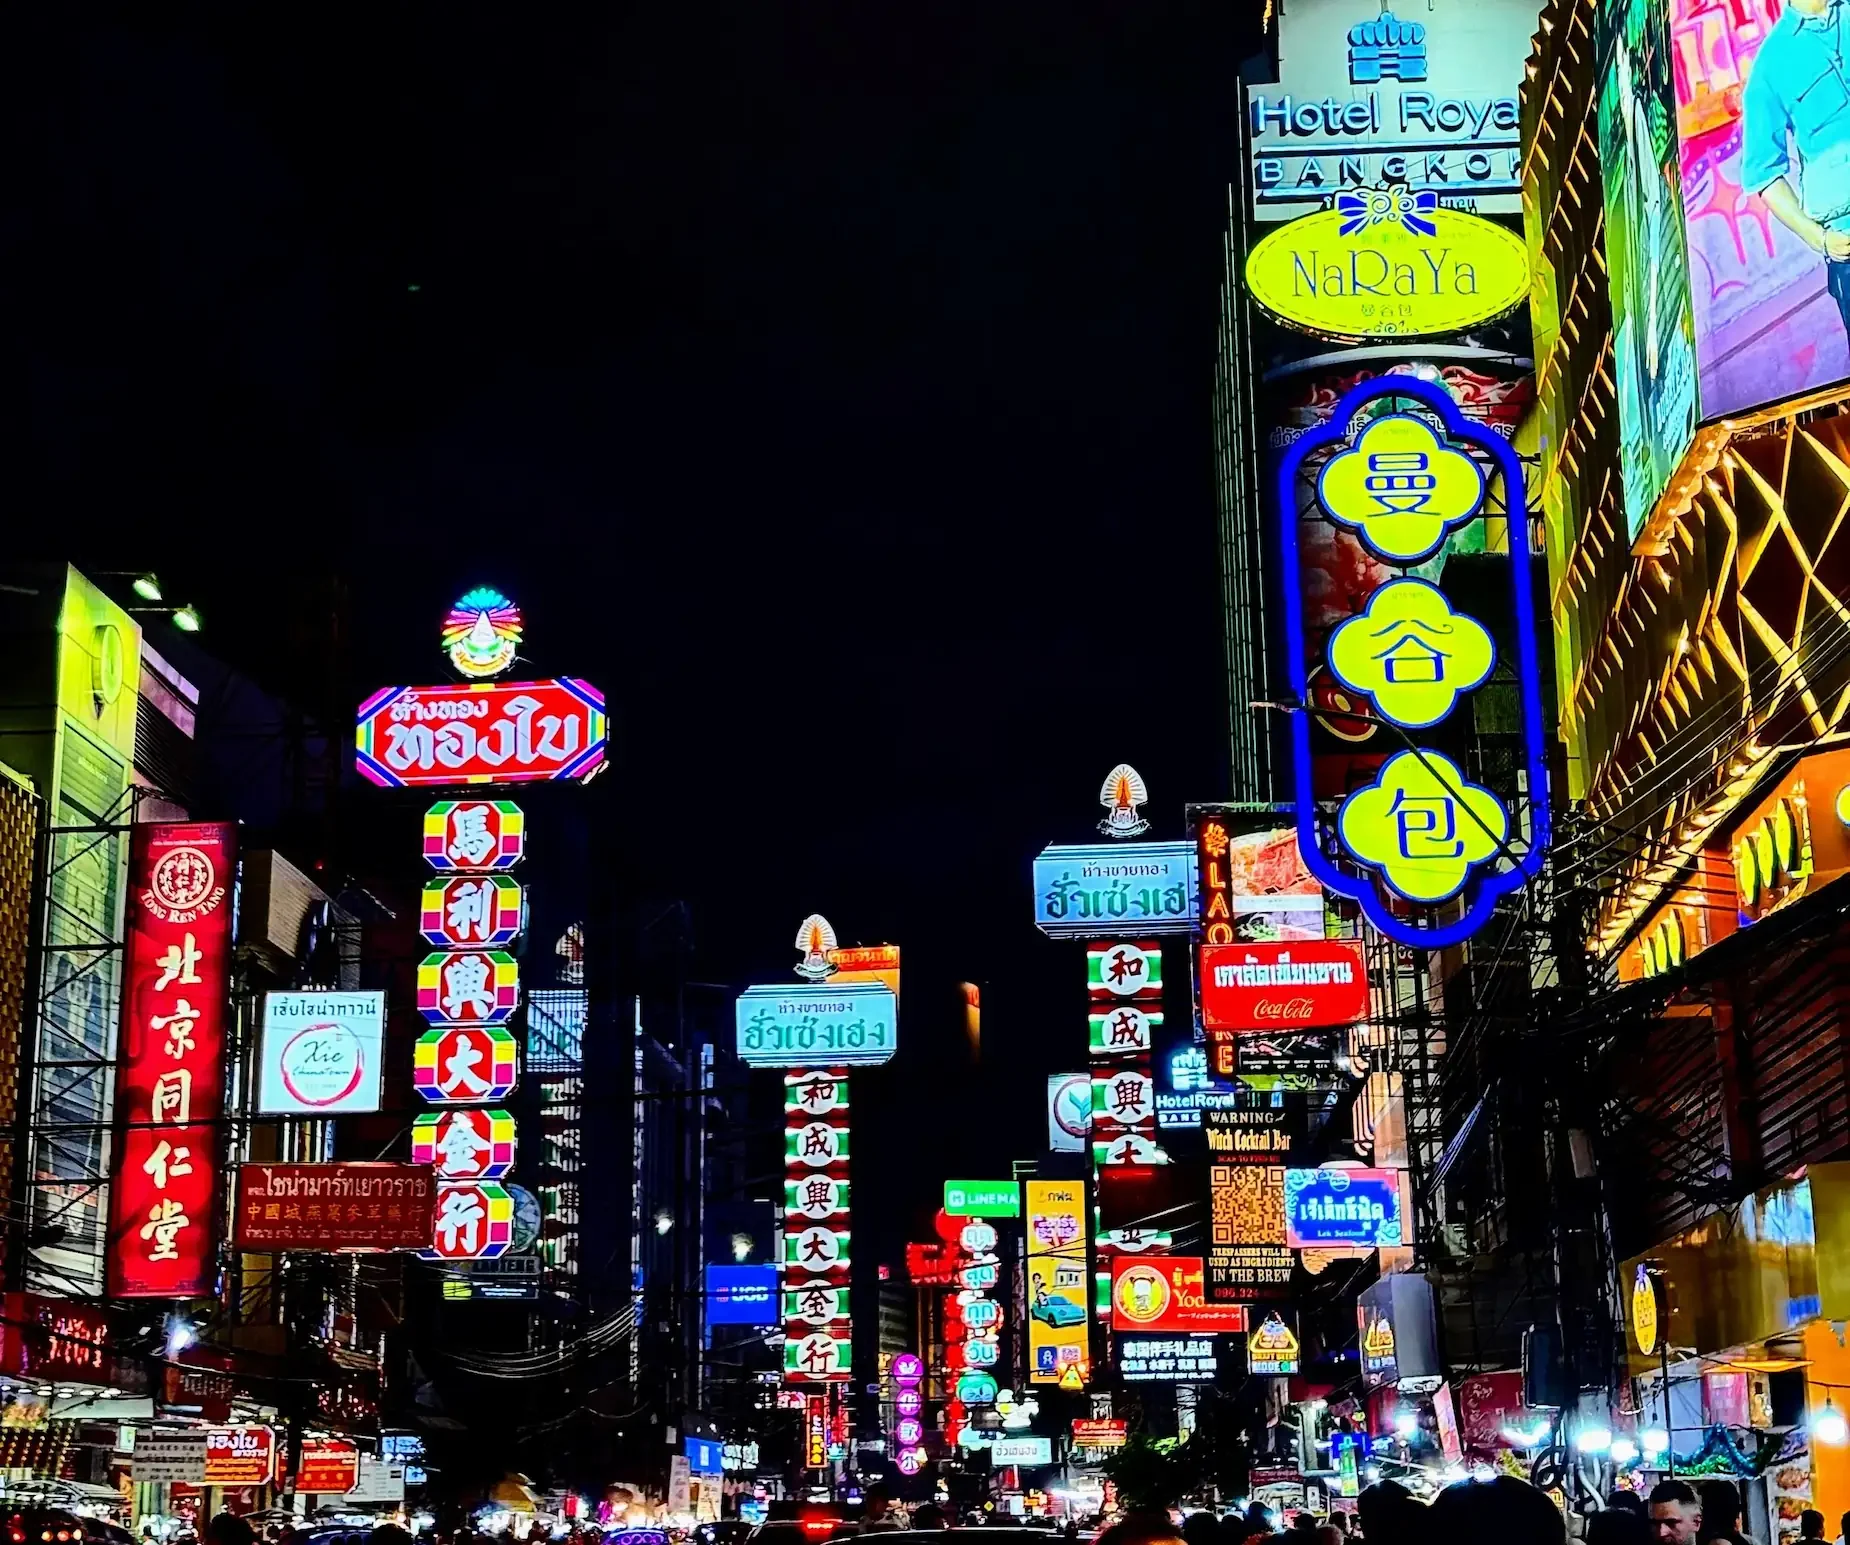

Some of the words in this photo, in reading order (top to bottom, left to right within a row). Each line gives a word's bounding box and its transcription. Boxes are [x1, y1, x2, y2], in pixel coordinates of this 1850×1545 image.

[1255, 93, 1381, 135] Hotel
[1400, 92, 1520, 140] Roya
[1290, 247, 1480, 297] NaRaYa
[1365, 452, 1465, 860] 曼谷包
[1082, 861, 1169, 878] ห้างขายทอง
[1045, 871, 1187, 919] ฮั่วเซ่งเฮ
[778, 1000, 853, 1014] ห้างขายทอง
[438, 806, 497, 1254] 馬利興大金行
[745, 1008, 886, 1050] ฮั่วเซ่งเฮง
[304, 1040, 344, 1063] Xie
[139, 932, 204, 1262] 北京同仁堂
[1156, 1094, 1195, 1108] Hotel
[1196, 1094, 1235, 1110] Royal
[1209, 1112, 1274, 1123] WARNING
[1272, 1128, 1291, 1151] Bar
[967, 1193, 996, 1205] LINE
[801, 1077, 835, 1375] 和成興大金行
[1208, 1257, 1229, 1267] USED
[1230, 1257, 1241, 1267] AS
[1242, 1257, 1295, 1267] INGREDIENTS
[1261, 1247, 1280, 1256] WILL
[1212, 1268, 1226, 1282] IN
[1229, 1268, 1254, 1282] THE
[1257, 1268, 1291, 1282] BREW
[732, 1286, 768, 1302] UOB
